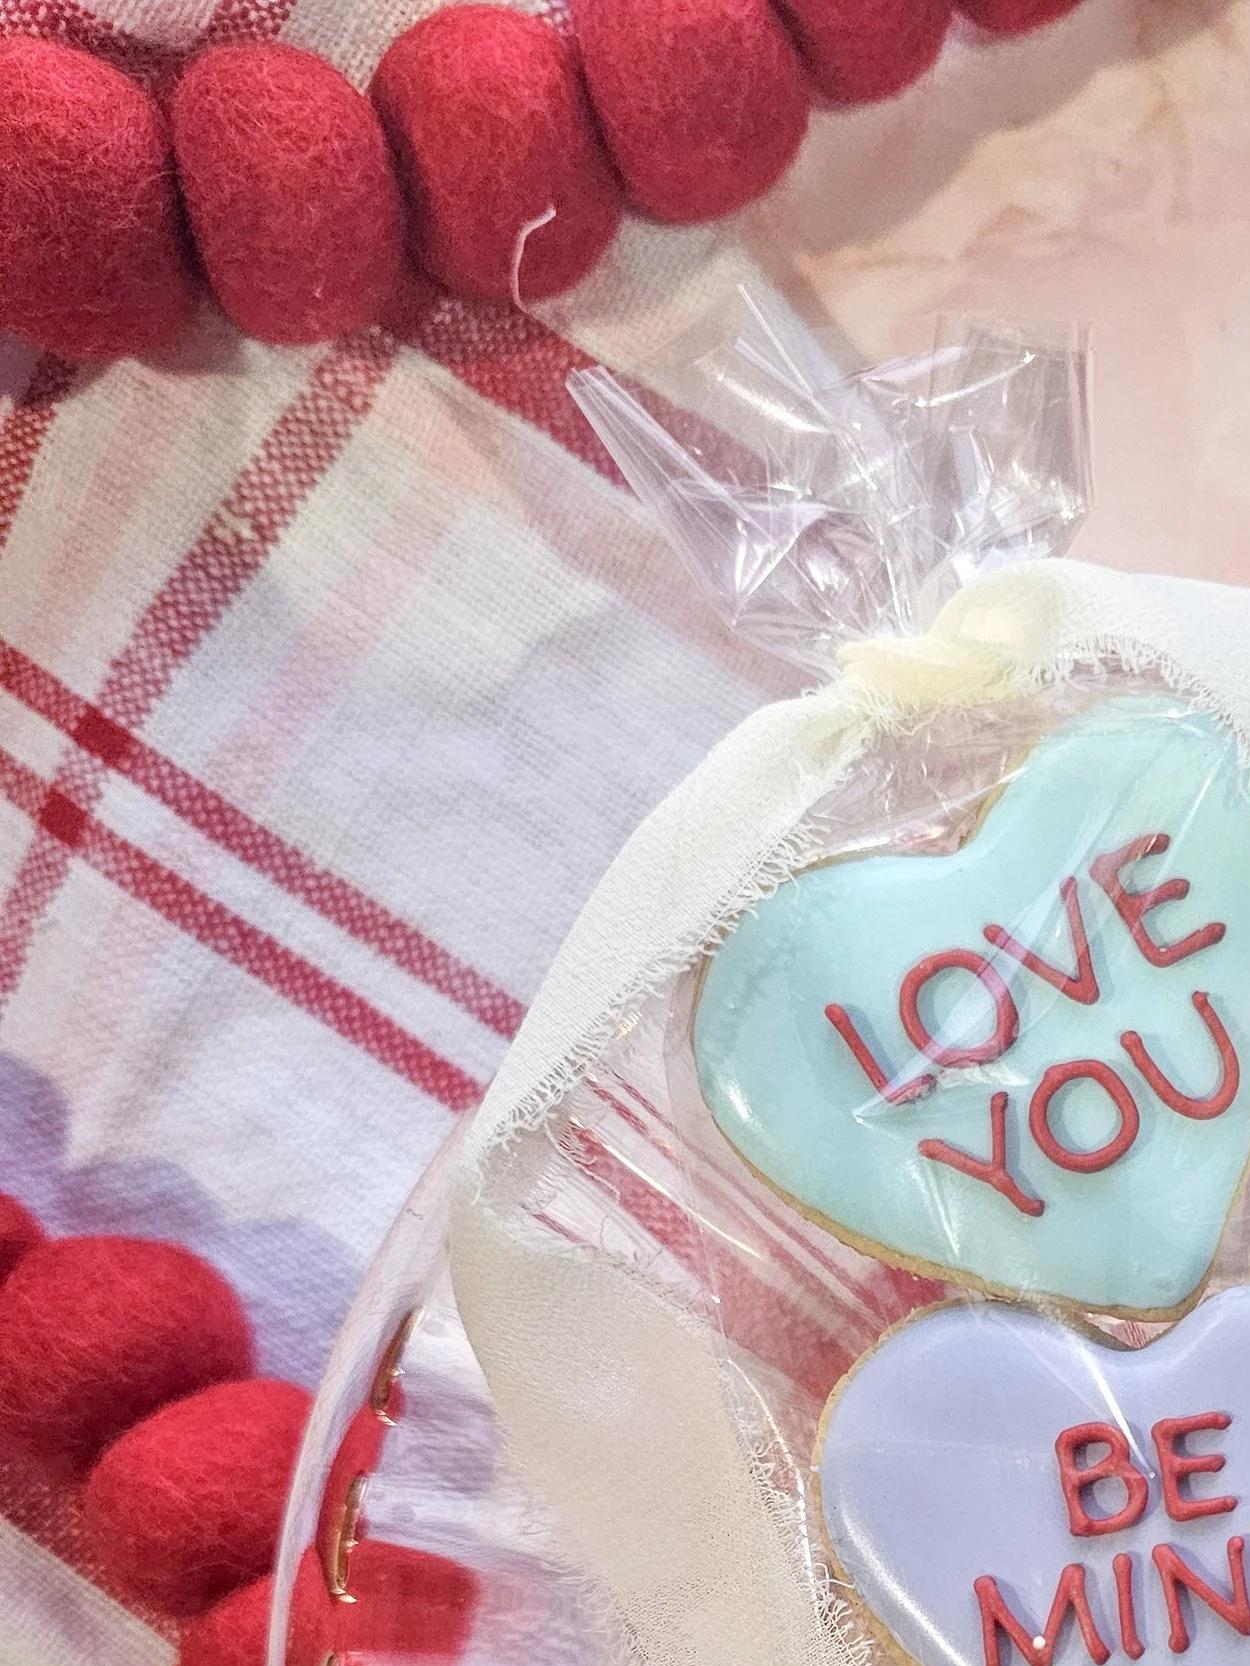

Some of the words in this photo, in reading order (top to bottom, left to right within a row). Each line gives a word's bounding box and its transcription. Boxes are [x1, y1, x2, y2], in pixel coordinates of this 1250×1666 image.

[824, 831, 1227, 1105] LOVE
[917, 990, 1240, 1218] YOU
[1054, 1411, 1238, 1538] BE
